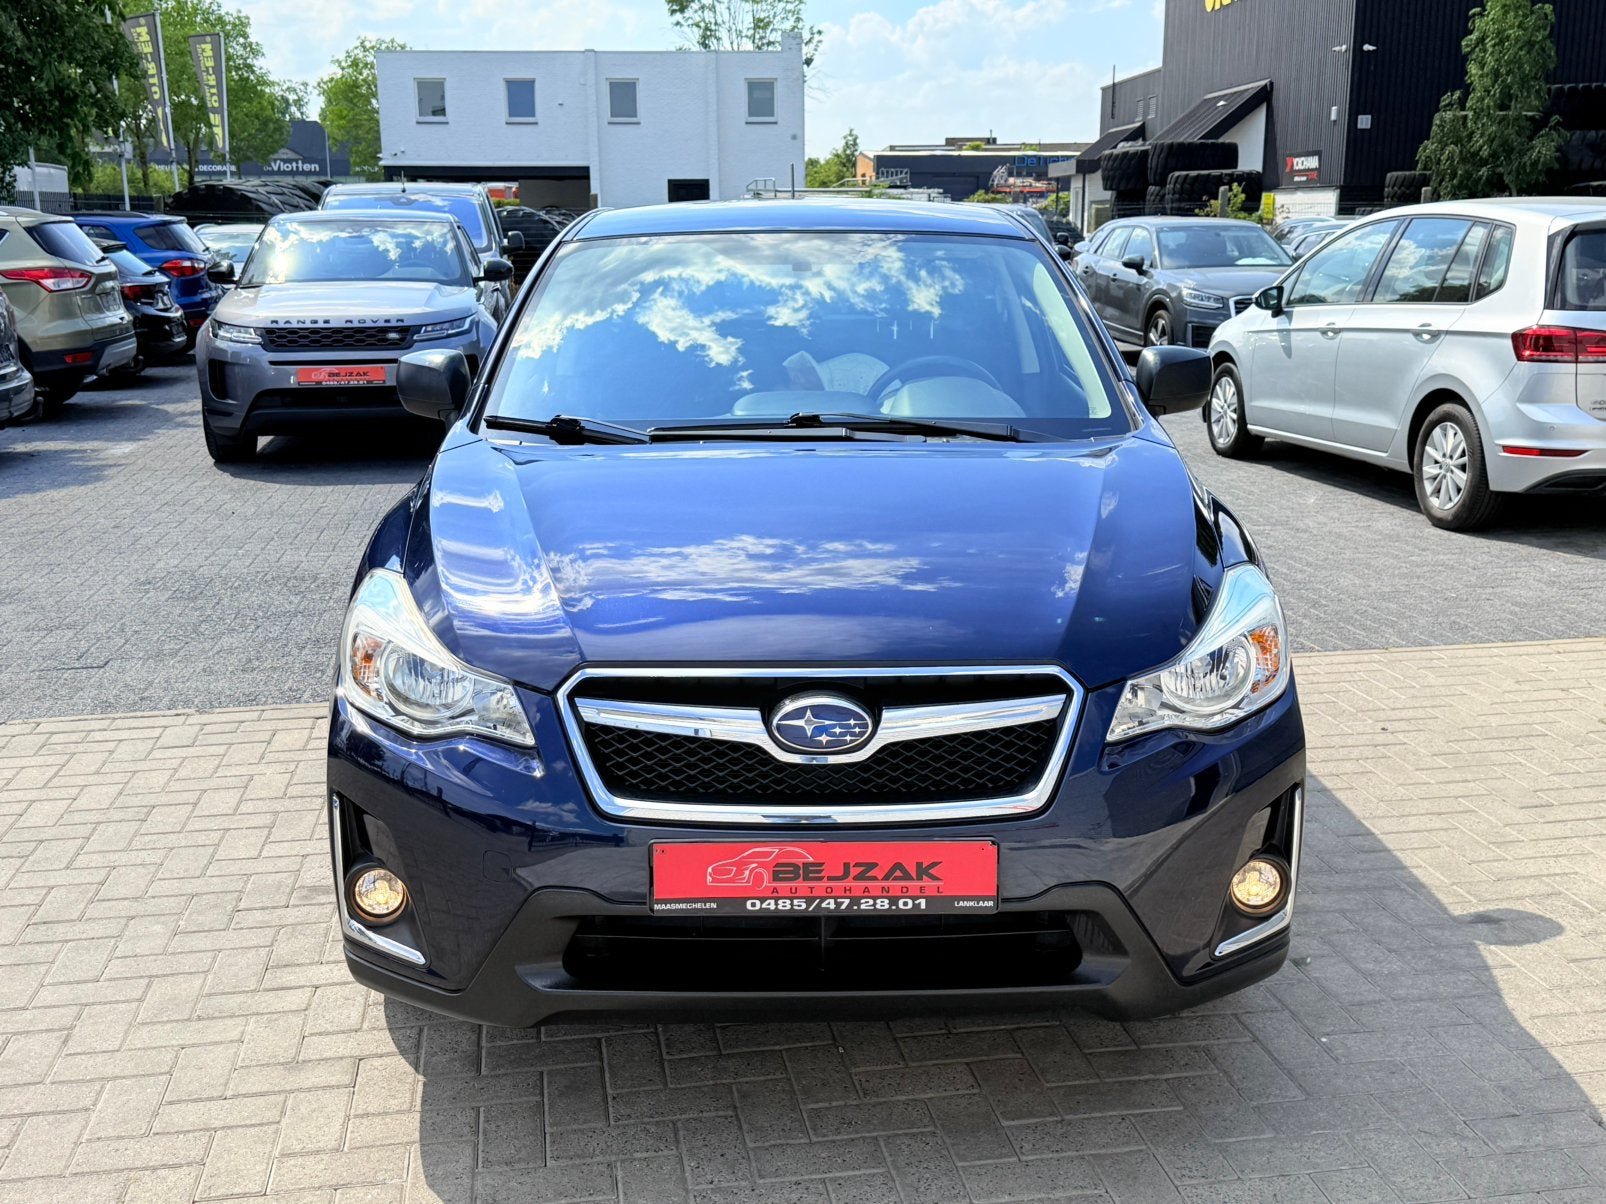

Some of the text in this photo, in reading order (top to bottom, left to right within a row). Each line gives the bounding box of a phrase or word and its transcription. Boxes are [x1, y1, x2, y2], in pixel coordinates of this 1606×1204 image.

[271, 160, 319, 171] Vlotten
[771, 861, 944, 882] BEJZAK
[771, 886, 944, 895] AUTOHANDEL
[654, 898, 994, 911] MAASMECHELEN 0485/47.28.01 LANKLAAR
